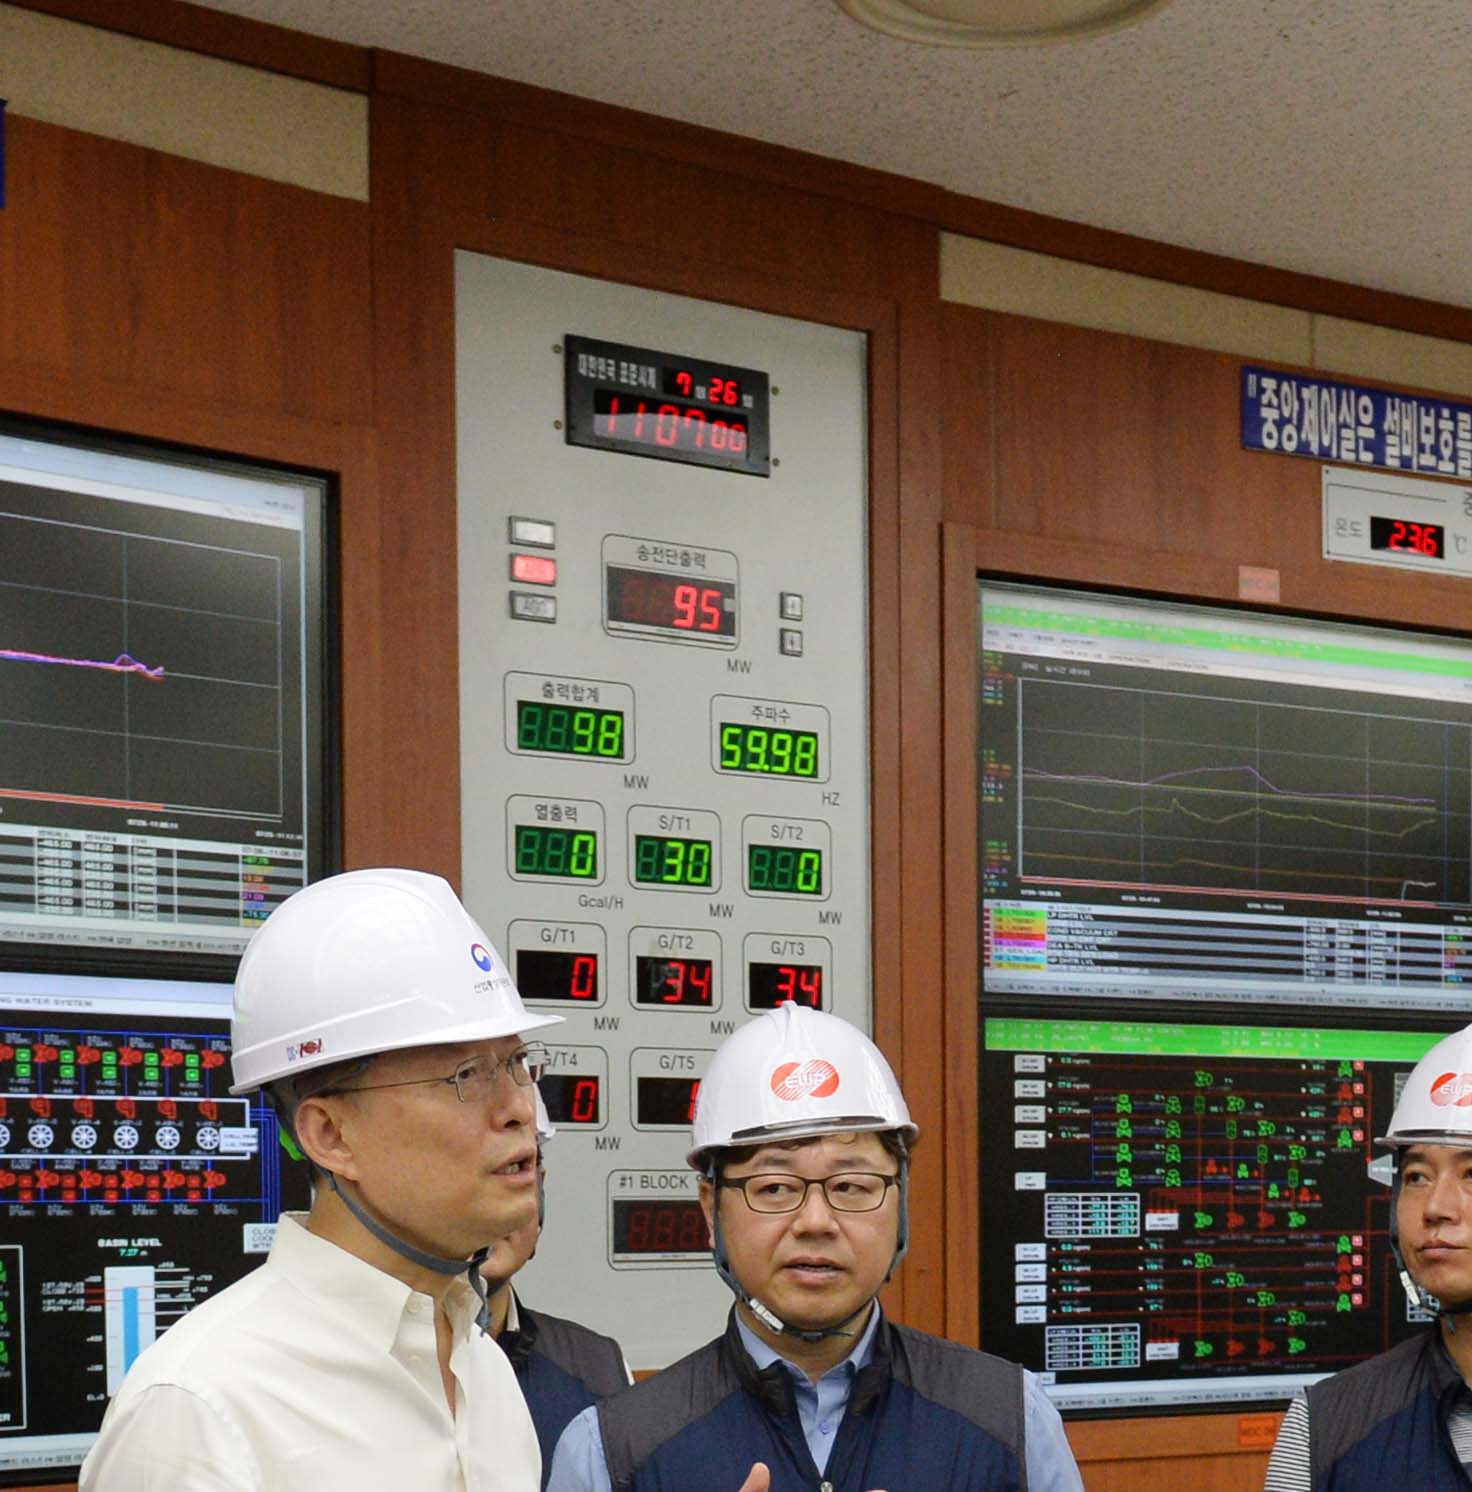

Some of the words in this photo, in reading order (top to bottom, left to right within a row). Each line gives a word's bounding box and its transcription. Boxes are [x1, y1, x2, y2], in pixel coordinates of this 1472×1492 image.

[578, 353, 617, 382] 대한민국
[619, 357, 656, 389] 표준시계
[676, 373, 691, 396] 7
[709, 378, 738, 405] 26
[1384, 397, 1472, 478] 설비보호를
[1334, 518, 1363, 539] 온도
[638, 543, 706, 570] 송전단출력
[674, 584, 721, 631] 95
[727, 658, 752, 674] MW
[542, 681, 600, 702] 출력합계
[752, 704, 791, 724] 주파수
[573, 712, 621, 757] 98
[624, 774, 649, 790] MW
[822, 790, 840, 806] HZ
[535, 802, 578, 824] 열출력
[658, 814, 691, 832] S/T1
[770, 823, 803, 842] S/T2
[570, 835, 594, 875] 0
[664, 842, 710, 884] 30
[797, 853, 819, 892] 0
[578, 893, 624, 910] Gcal/H
[709, 902, 734, 919] MW
[819, 910, 842, 926] MW
[540, 926, 576, 945] G/T1
[658, 932, 694, 951] G/T2
[770, 939, 805, 958] G/T3
[571, 955, 595, 997] 0
[663, 962, 712, 1003] 34
[776, 967, 820, 1005] 34
[594, 1015, 620, 1032] MW
[710, 1019, 735, 1035] MW
[659, 1053, 695, 1071] G/T5
[571, 1081, 595, 1121] 0
[594, 1135, 620, 1152] MW
[619, 1174, 635, 1190] #1
[640, 1174, 690, 1192] BLOCK
[131, 1237, 162, 1247] LEVEL
